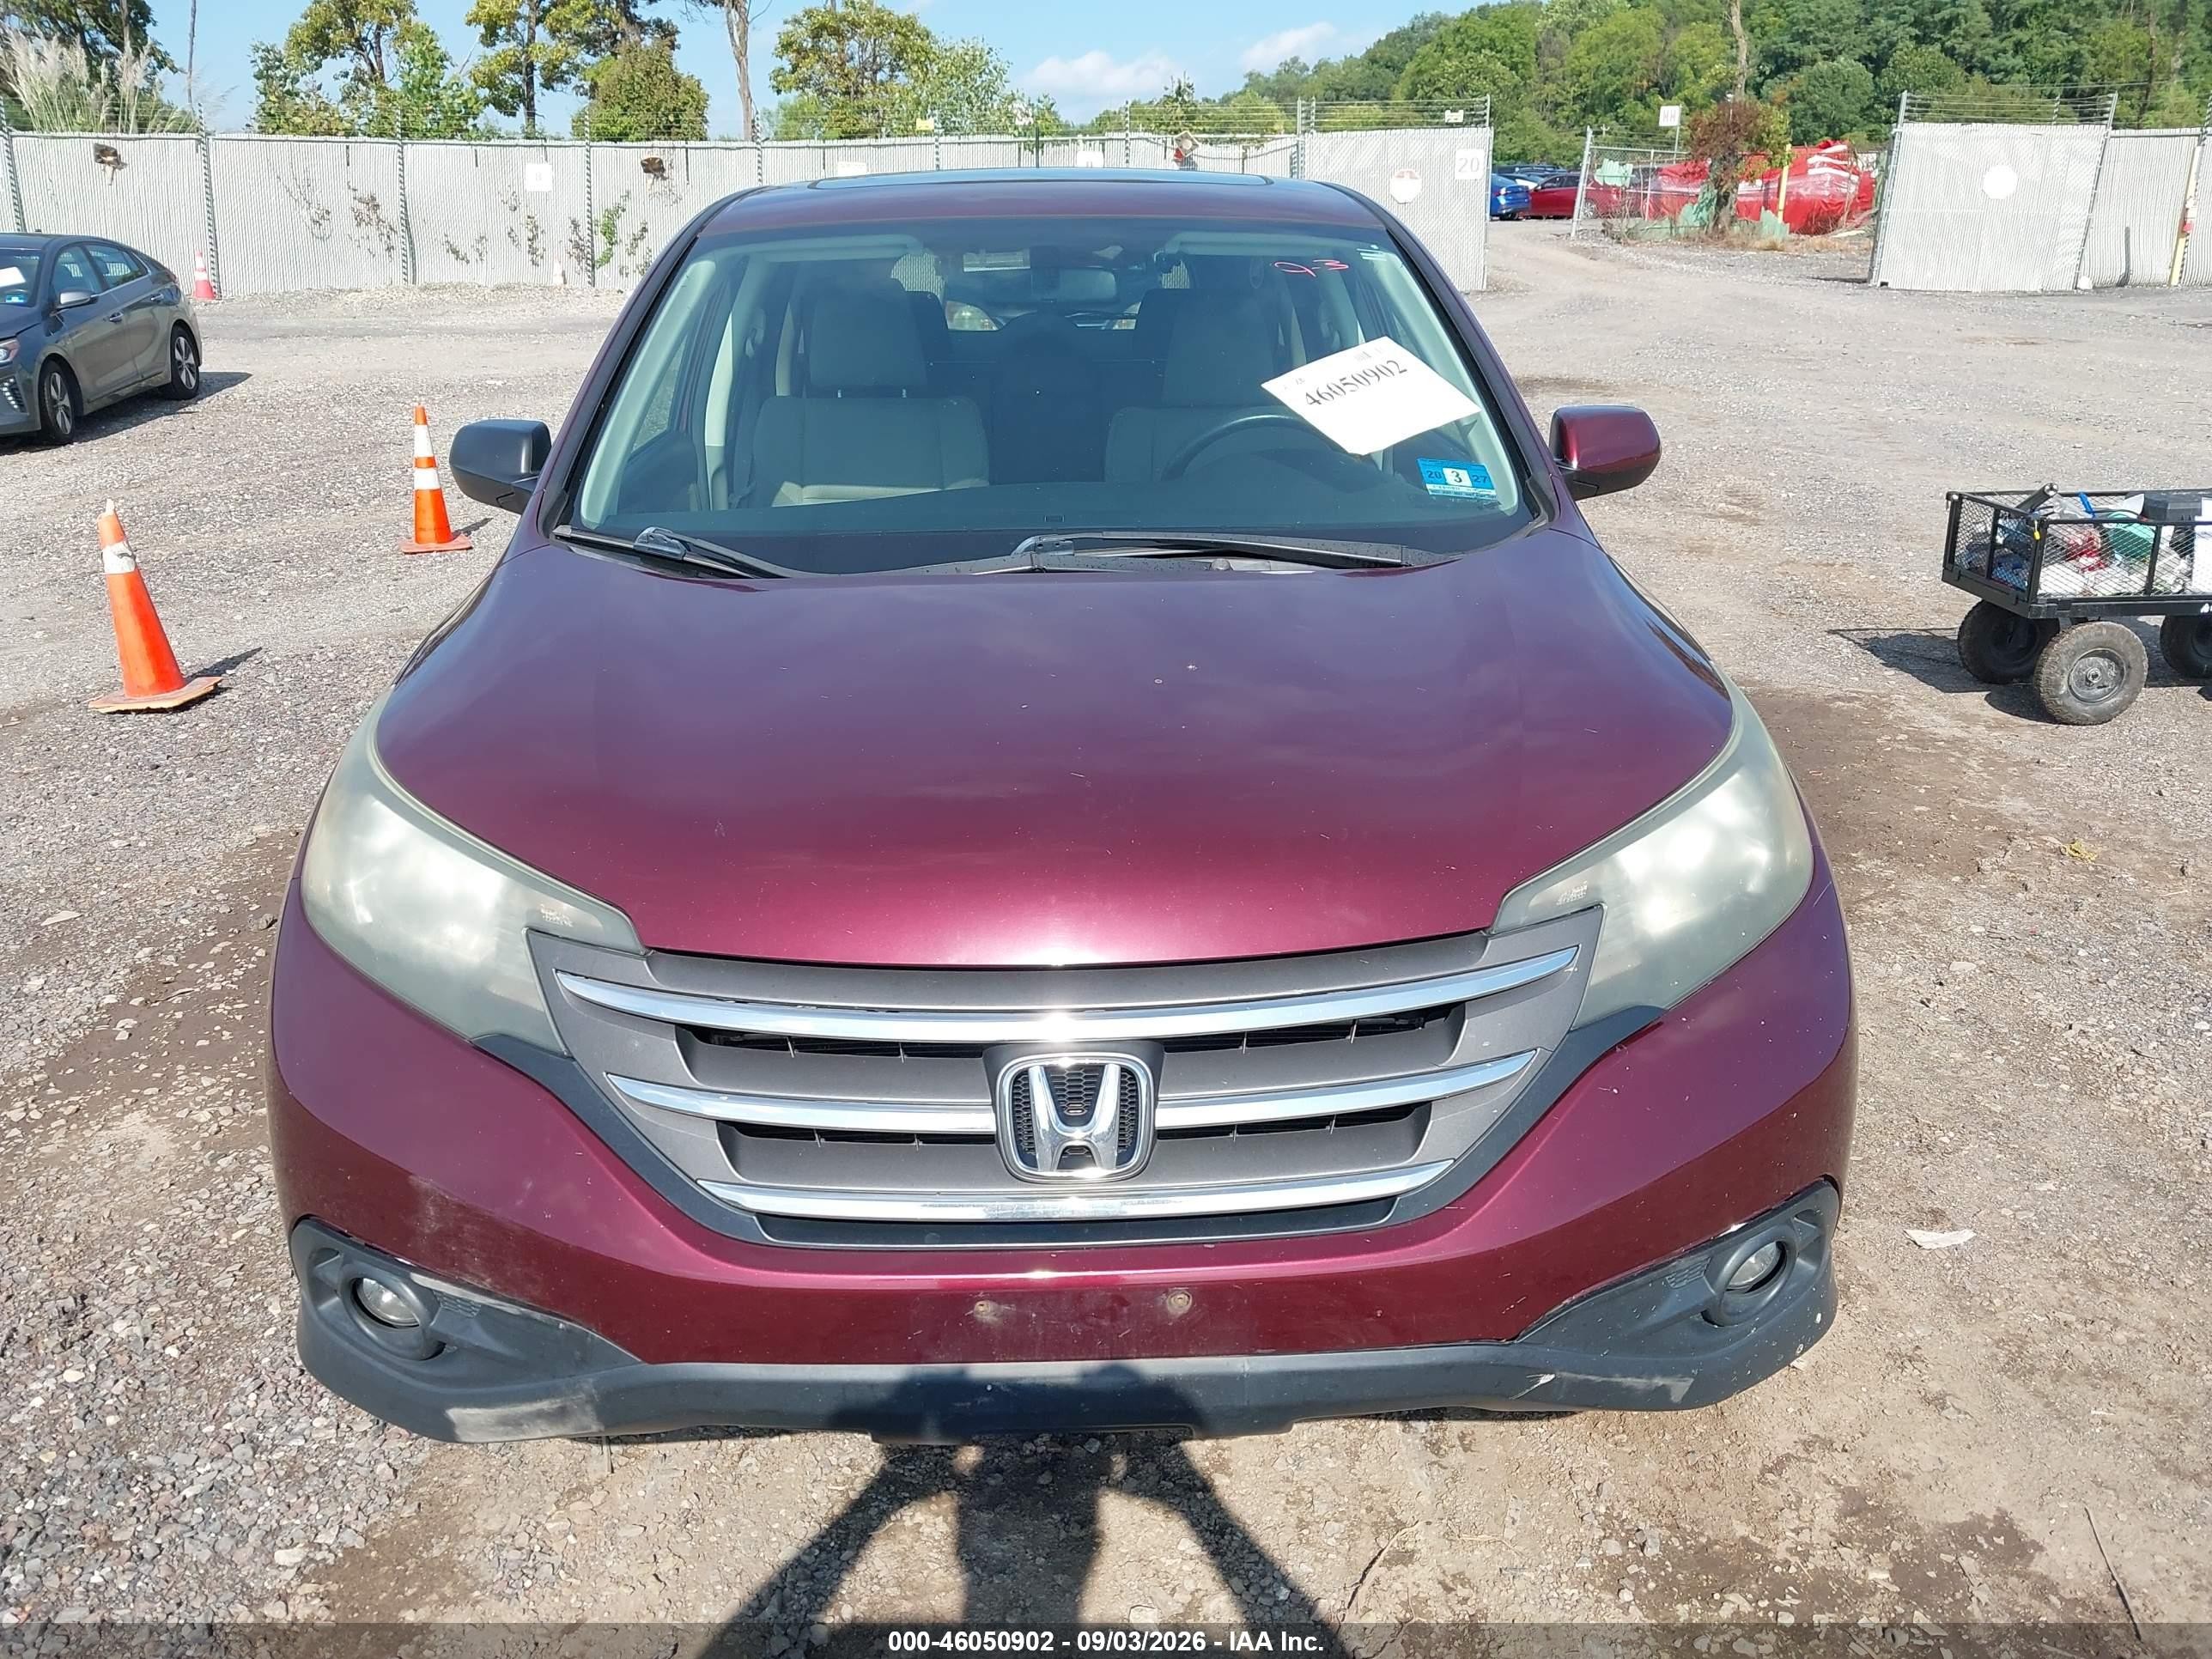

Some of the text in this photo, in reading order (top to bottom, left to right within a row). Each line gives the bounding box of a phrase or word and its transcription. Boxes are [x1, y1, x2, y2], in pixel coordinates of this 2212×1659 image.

[1458, 157, 1480, 173] 20
[1305, 360, 1407, 405] 46050902
[1426, 470, 1488, 484] 20 3 27
